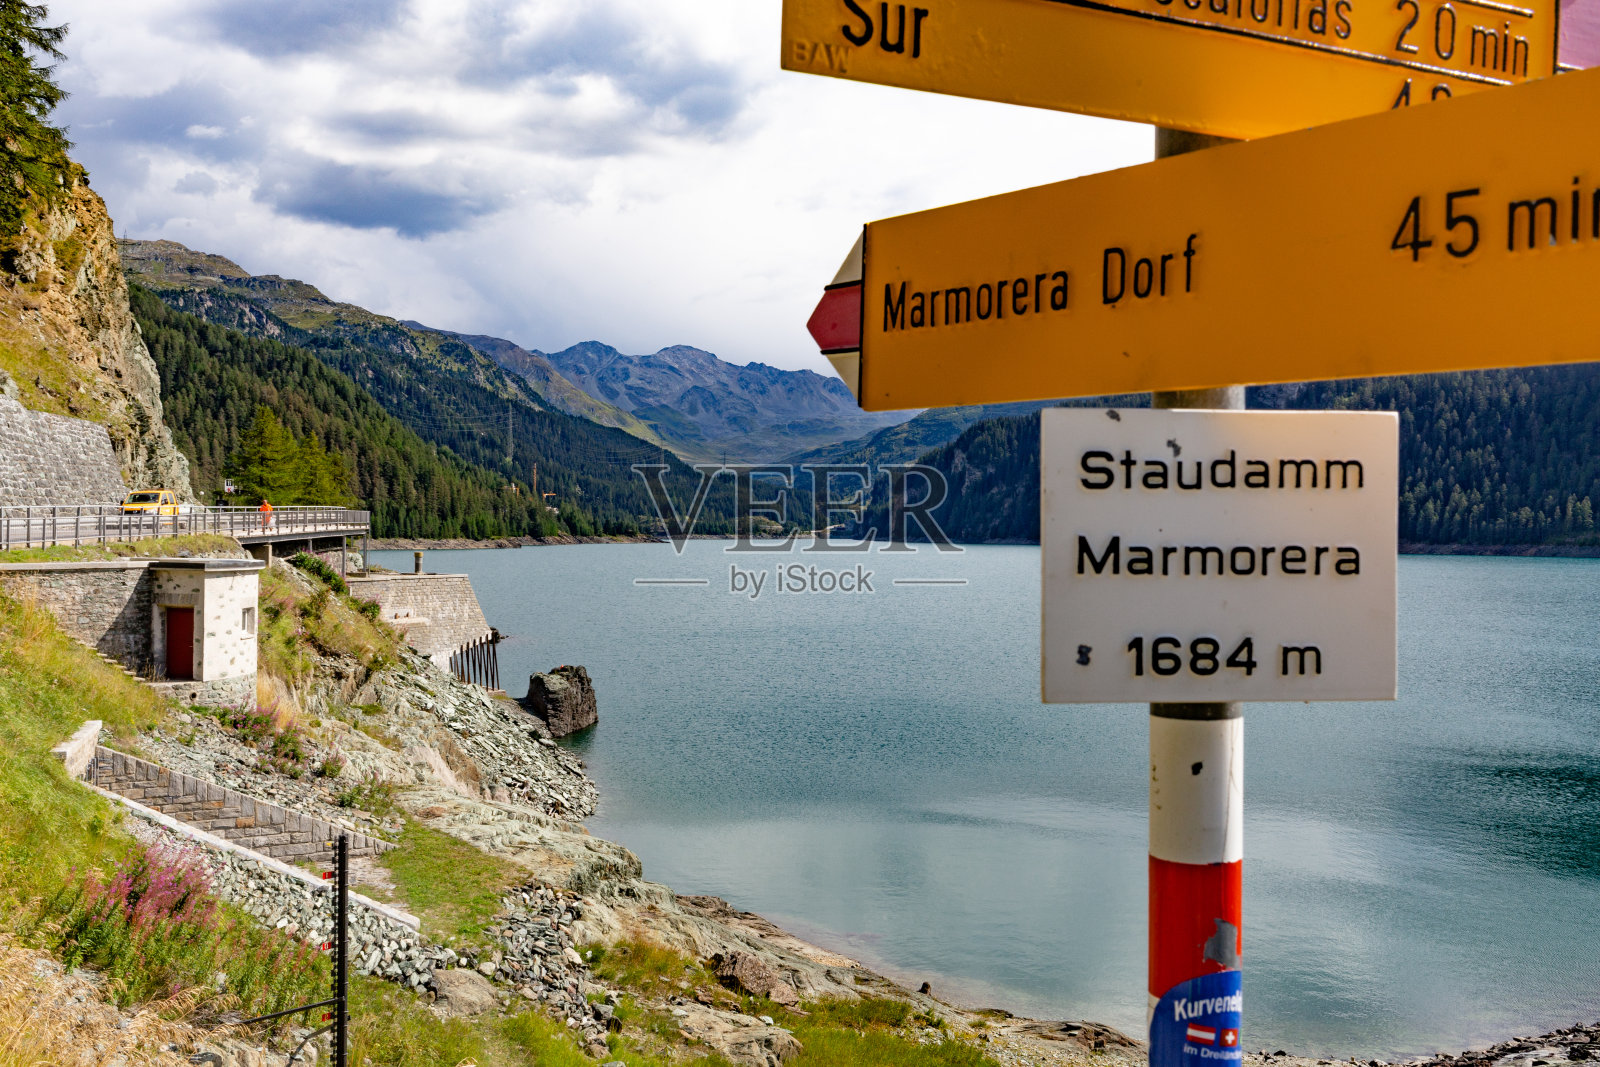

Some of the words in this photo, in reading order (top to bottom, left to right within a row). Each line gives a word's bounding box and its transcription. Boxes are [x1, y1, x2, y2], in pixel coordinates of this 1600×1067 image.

[842, 0, 929, 58] Sur
[1396, 0, 1456, 60] 20
[1470, 21, 1529, 77] min
[884, 270, 1069, 332] Marmorera
[1102, 233, 1198, 305] Dorf
[1390, 188, 1480, 262] 45
[1080, 450, 1365, 490] Staudamm
[1077, 535, 1361, 576] Marmorera
[1127, 636, 1257, 676] 1684
[1281, 645, 1322, 676] m
